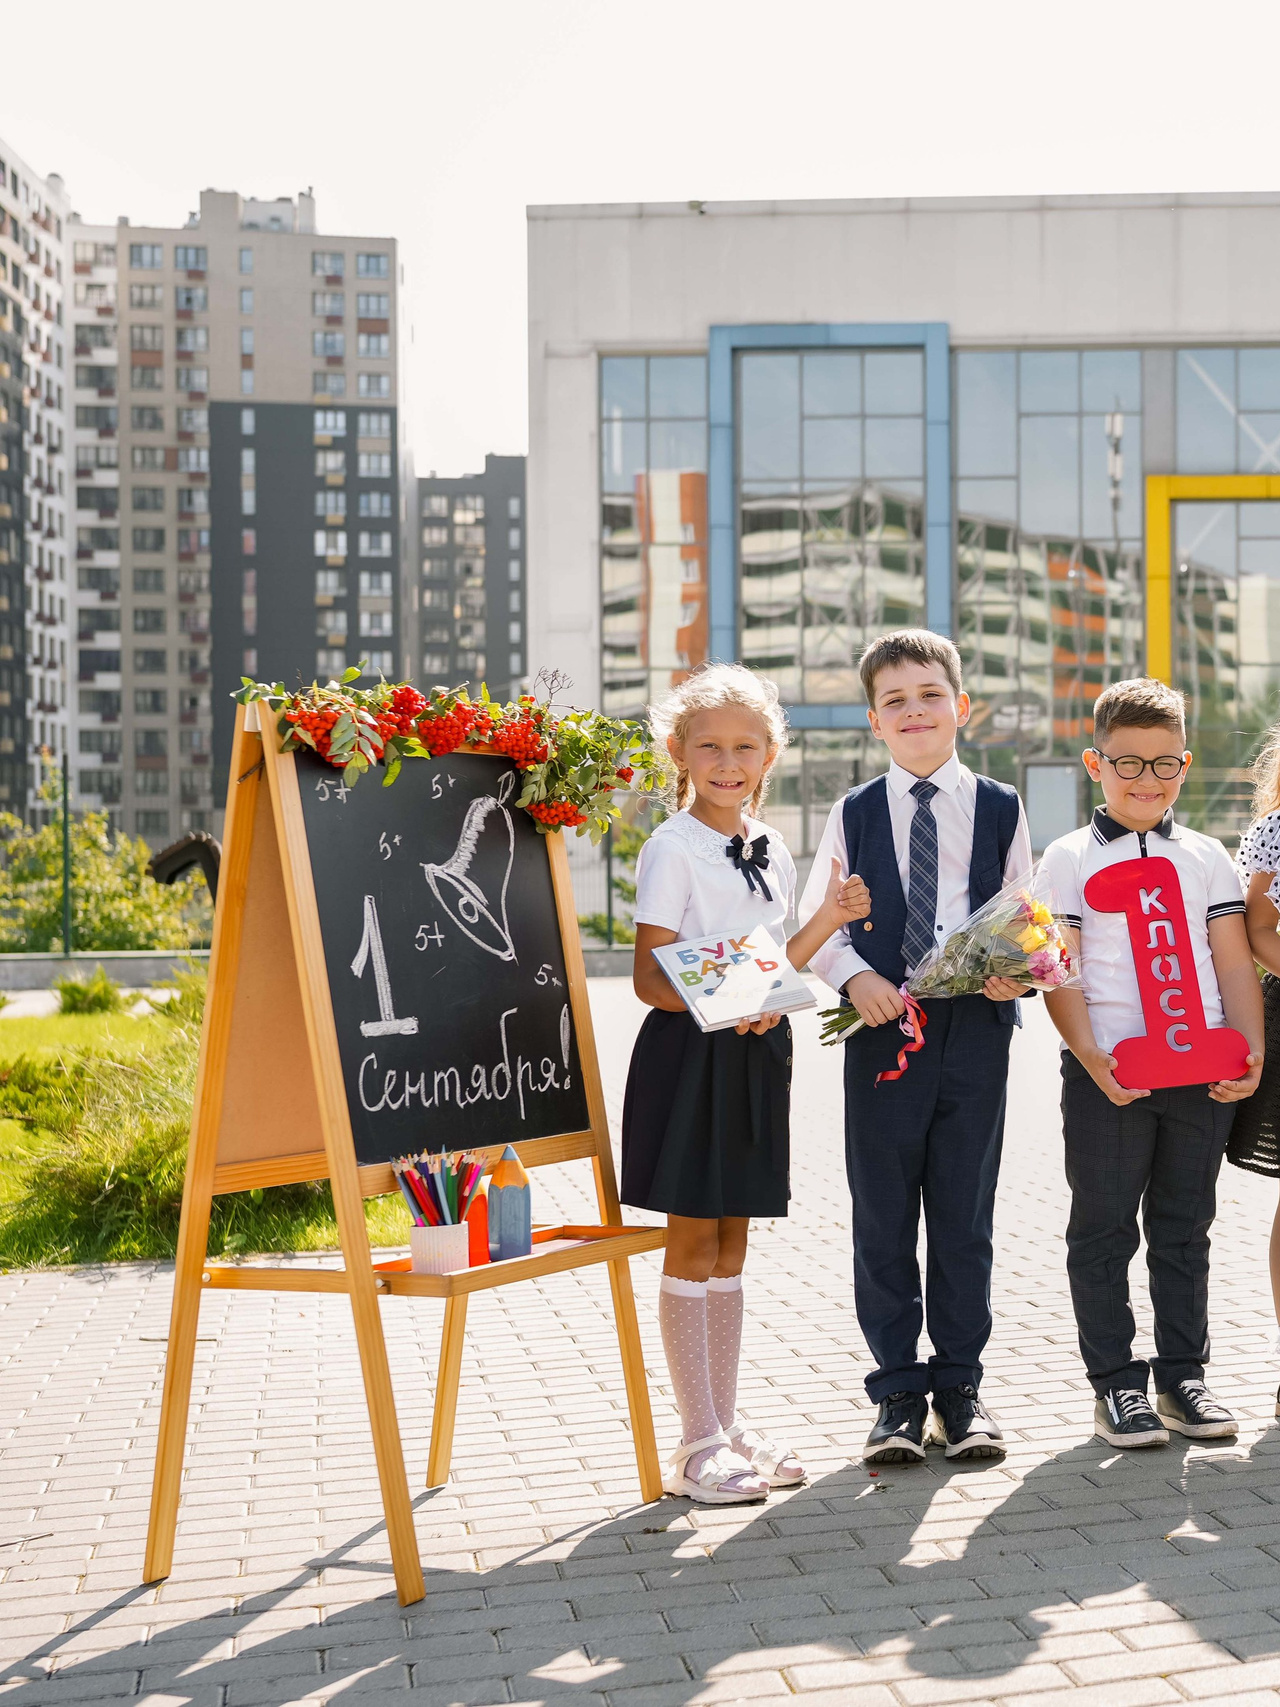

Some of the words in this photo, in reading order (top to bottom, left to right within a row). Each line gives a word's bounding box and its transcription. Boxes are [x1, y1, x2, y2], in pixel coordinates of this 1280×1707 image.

[431, 773, 456, 799] 5+
[378, 831, 403, 861] 5+
[414, 921, 445, 951] 5+
[350, 894, 419, 1038] 1
[358, 1003, 571, 1120] Сентября!
